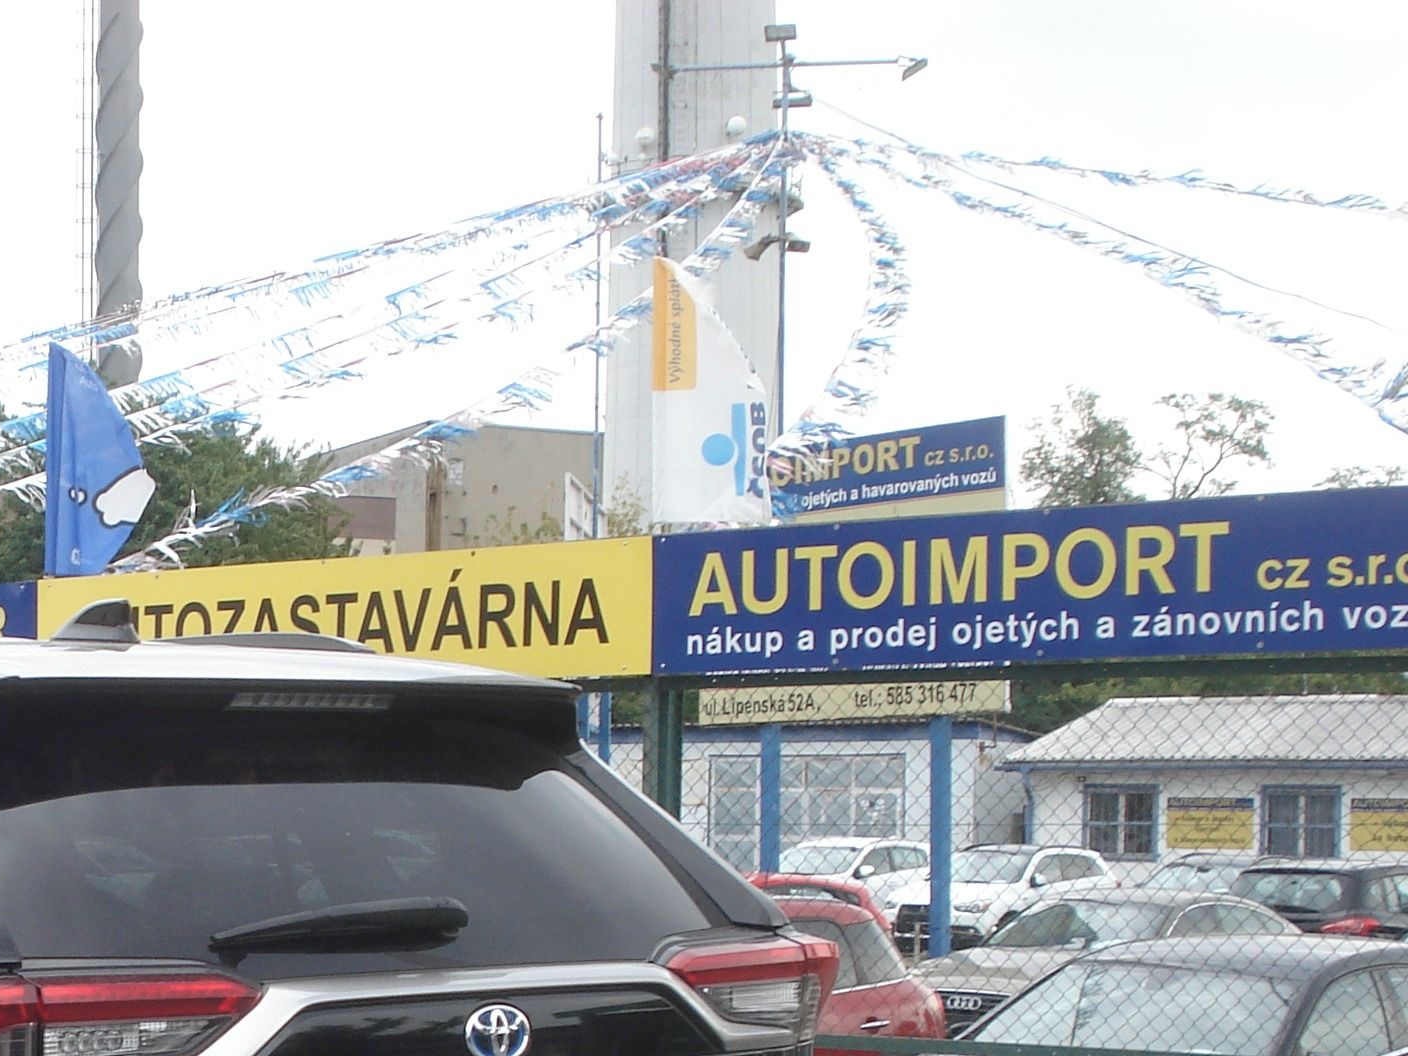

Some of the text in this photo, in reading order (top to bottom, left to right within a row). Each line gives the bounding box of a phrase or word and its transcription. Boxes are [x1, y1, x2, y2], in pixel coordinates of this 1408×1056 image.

[924, 449, 945, 467] cz
[949, 444, 995, 463] s.r.o.
[801, 486, 847, 510] ojetých
[850, 488, 859, 500] a
[862, 471, 960, 499] havarovaných
[962, 467, 997, 486] vozů
[688, 520, 1231, 617] AUTOIMPORT
[1256, 557, 1311, 591] cz
[686, 625, 784, 657] nákup
[797, 628, 815, 651] a
[830, 616, 937, 655] prodej
[952, 610, 1080, 650] ojetých
[1095, 616, 1115, 639] a
[1131, 600, 1324, 638] zánovních
[886, 685, 913, 705] 585
[918, 684, 945, 704] 316
[950, 682, 977, 703] 477
